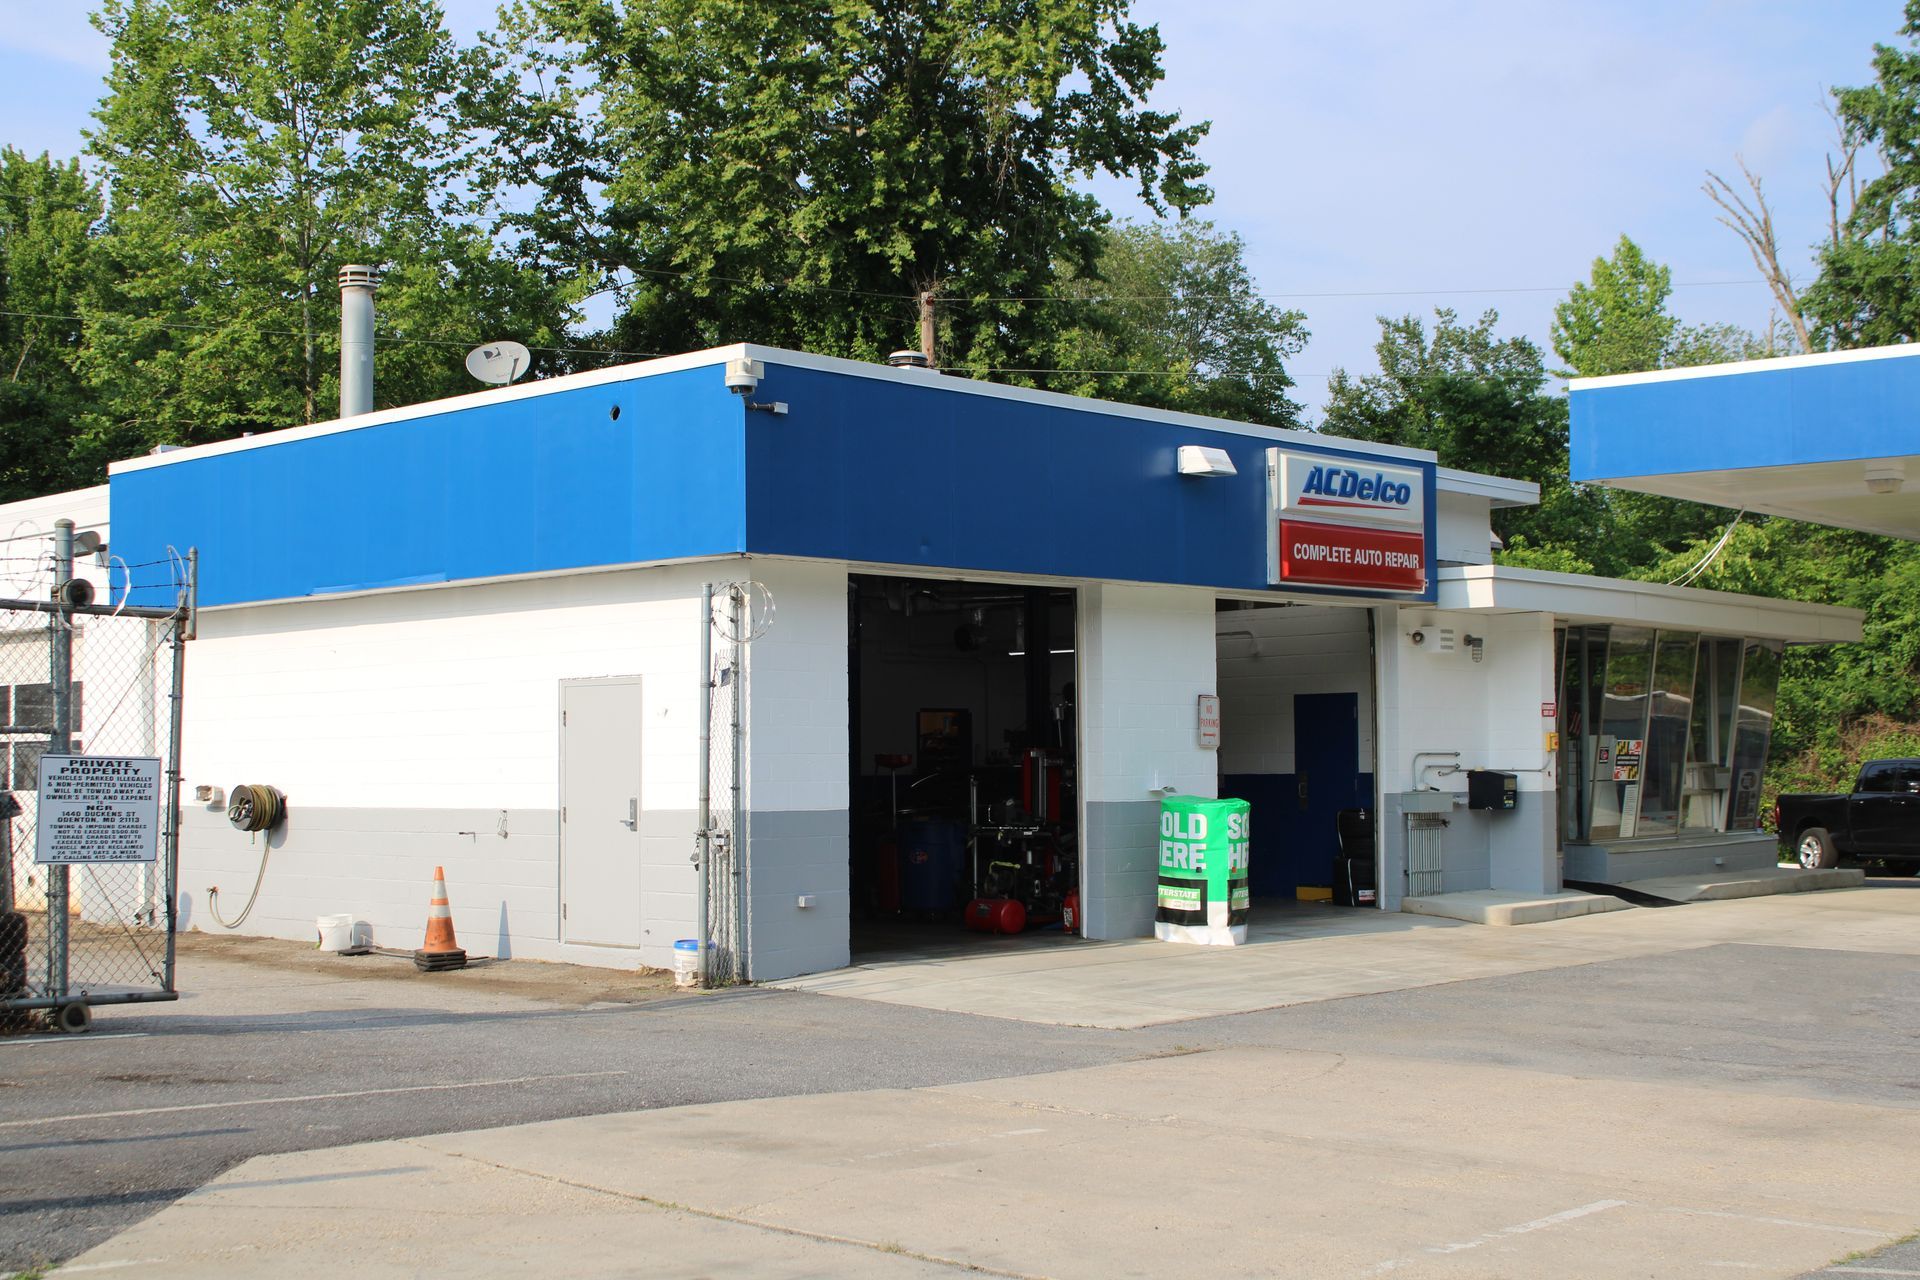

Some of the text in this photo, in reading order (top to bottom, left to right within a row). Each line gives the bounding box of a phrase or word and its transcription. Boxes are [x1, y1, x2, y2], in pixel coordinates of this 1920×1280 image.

[1302, 465, 1411, 505] ACDelco
[1293, 543, 1419, 569] COMPLETE AUTO REPAIR
[61, 767, 141, 775] PROPERTY
[70, 760, 133, 768] PRIVATE
[1160, 811, 1208, 840] OLD
[1227, 812, 1250, 840] SO
[1158, 887, 1198, 899] TERSTATE
